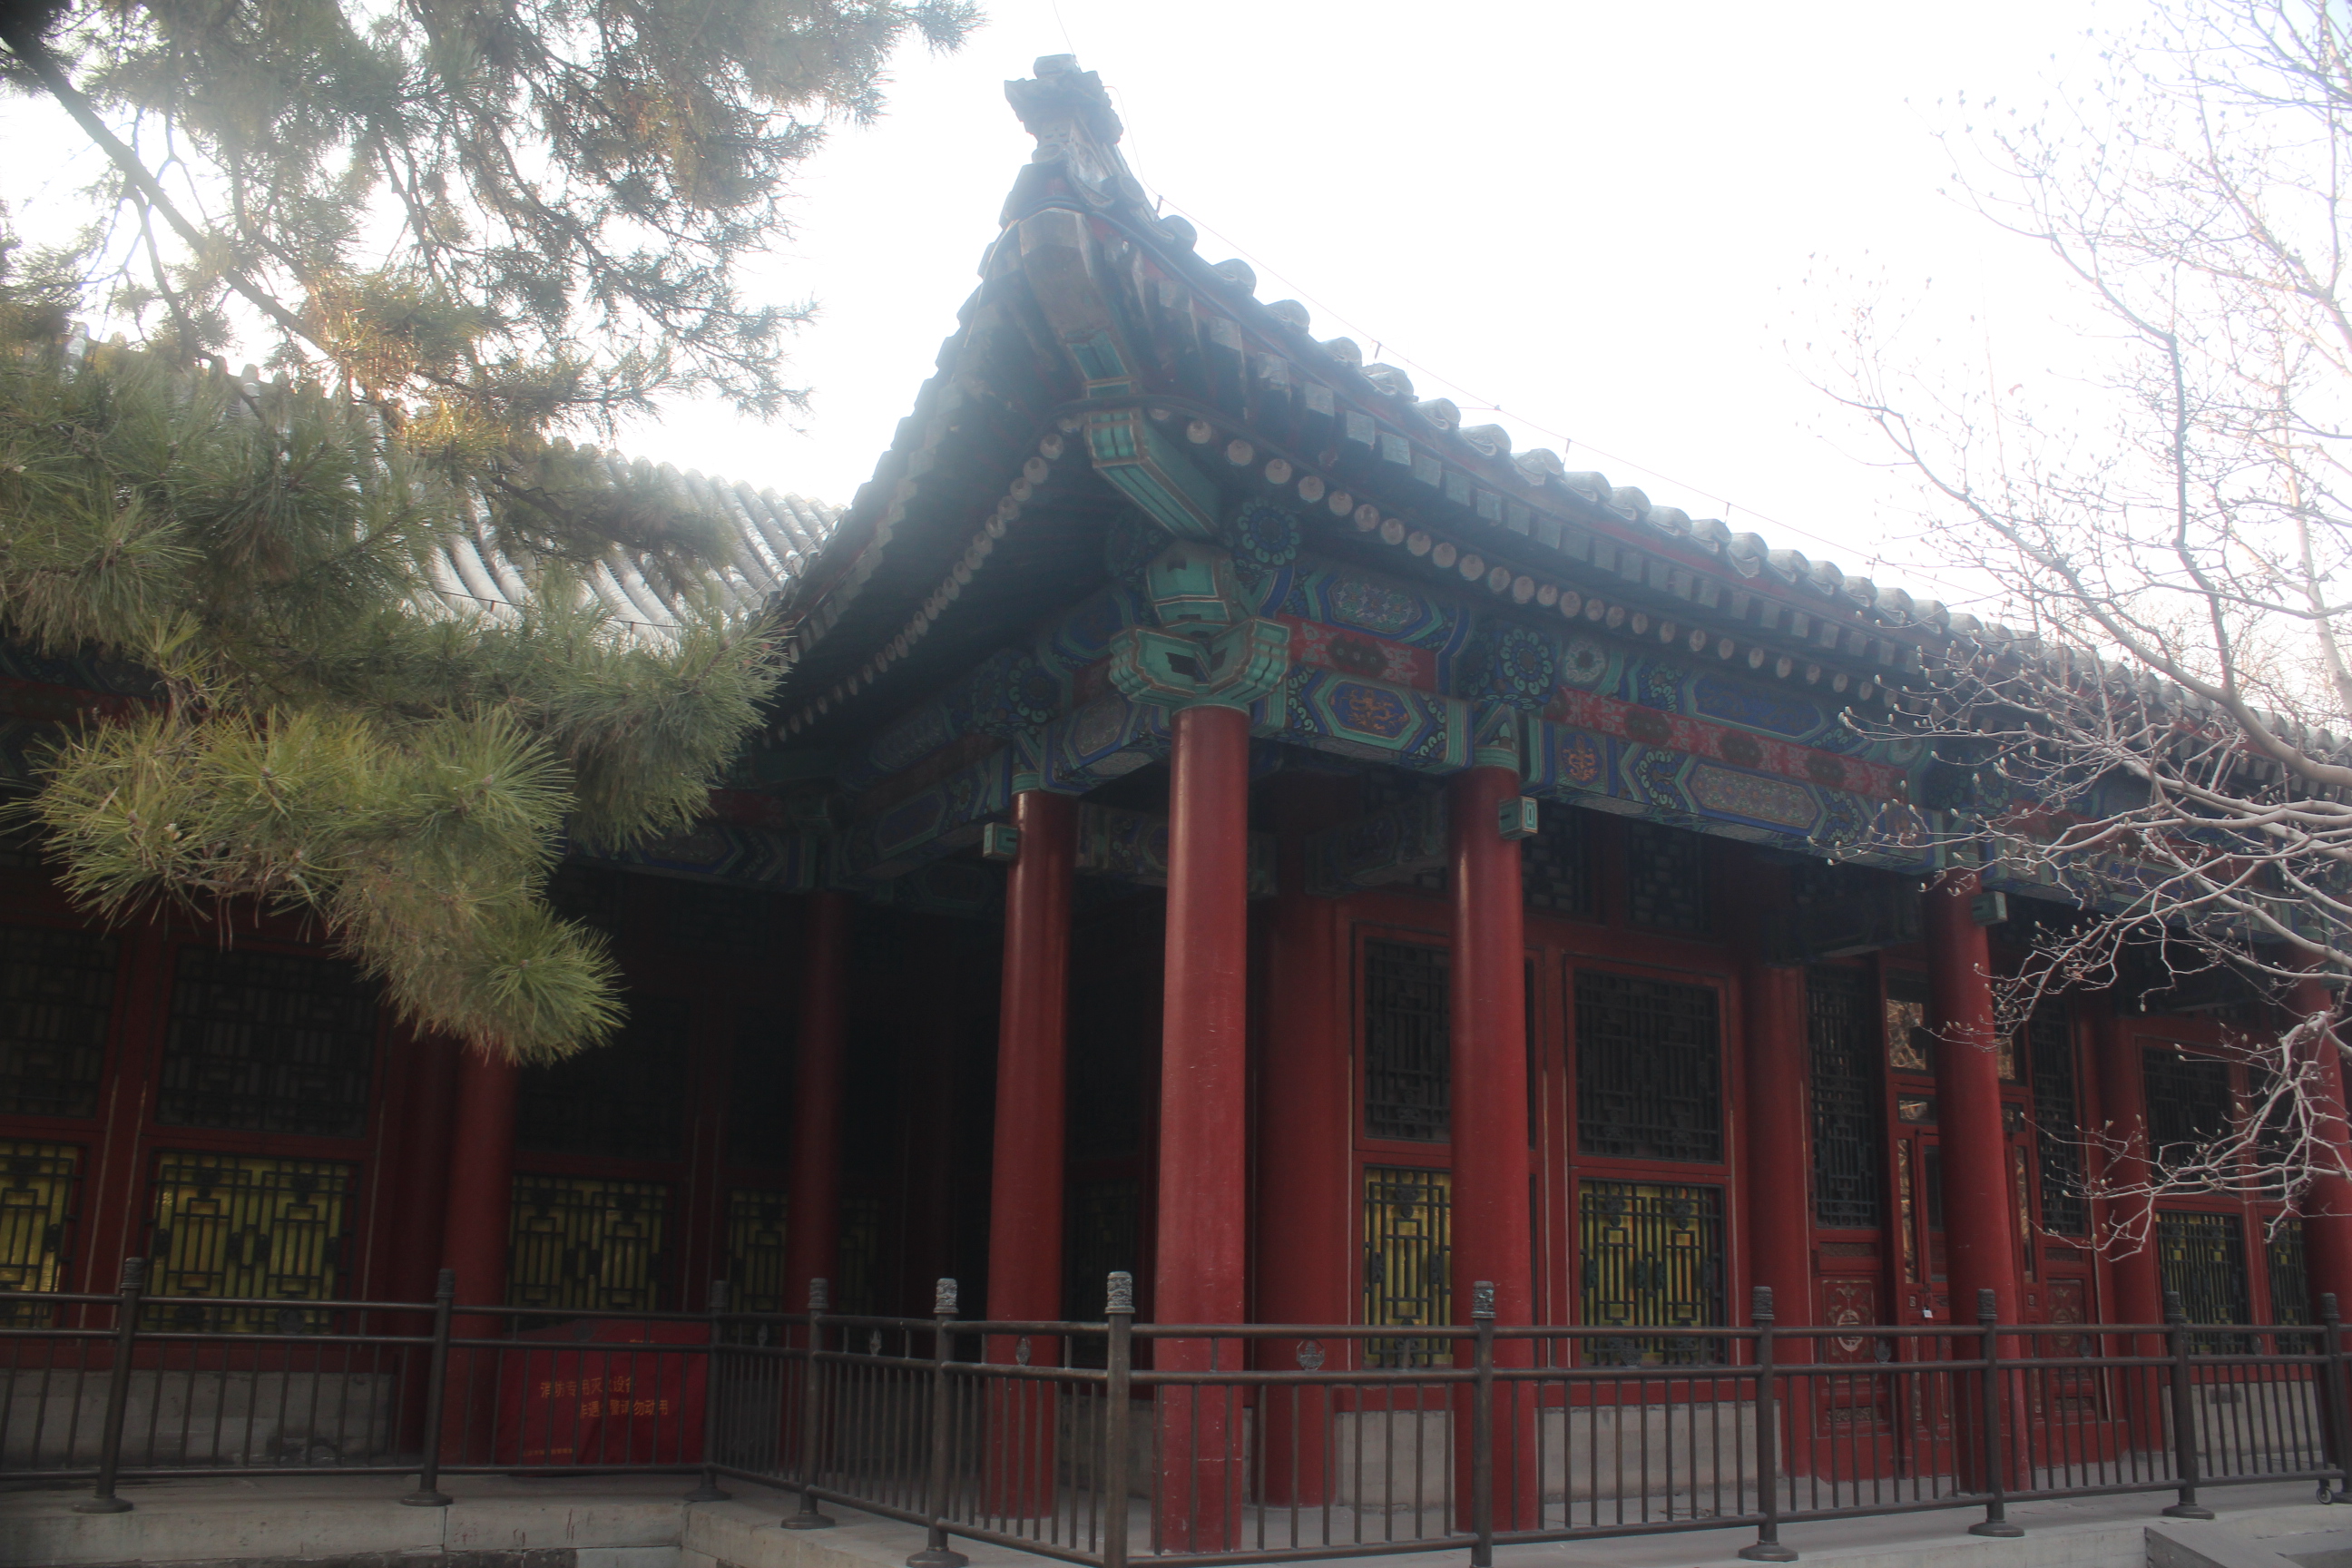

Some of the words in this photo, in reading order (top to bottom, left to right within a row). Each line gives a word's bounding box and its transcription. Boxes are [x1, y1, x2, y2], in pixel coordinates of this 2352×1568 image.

[540, 1376, 636, 1398] 消防专用灭设备
